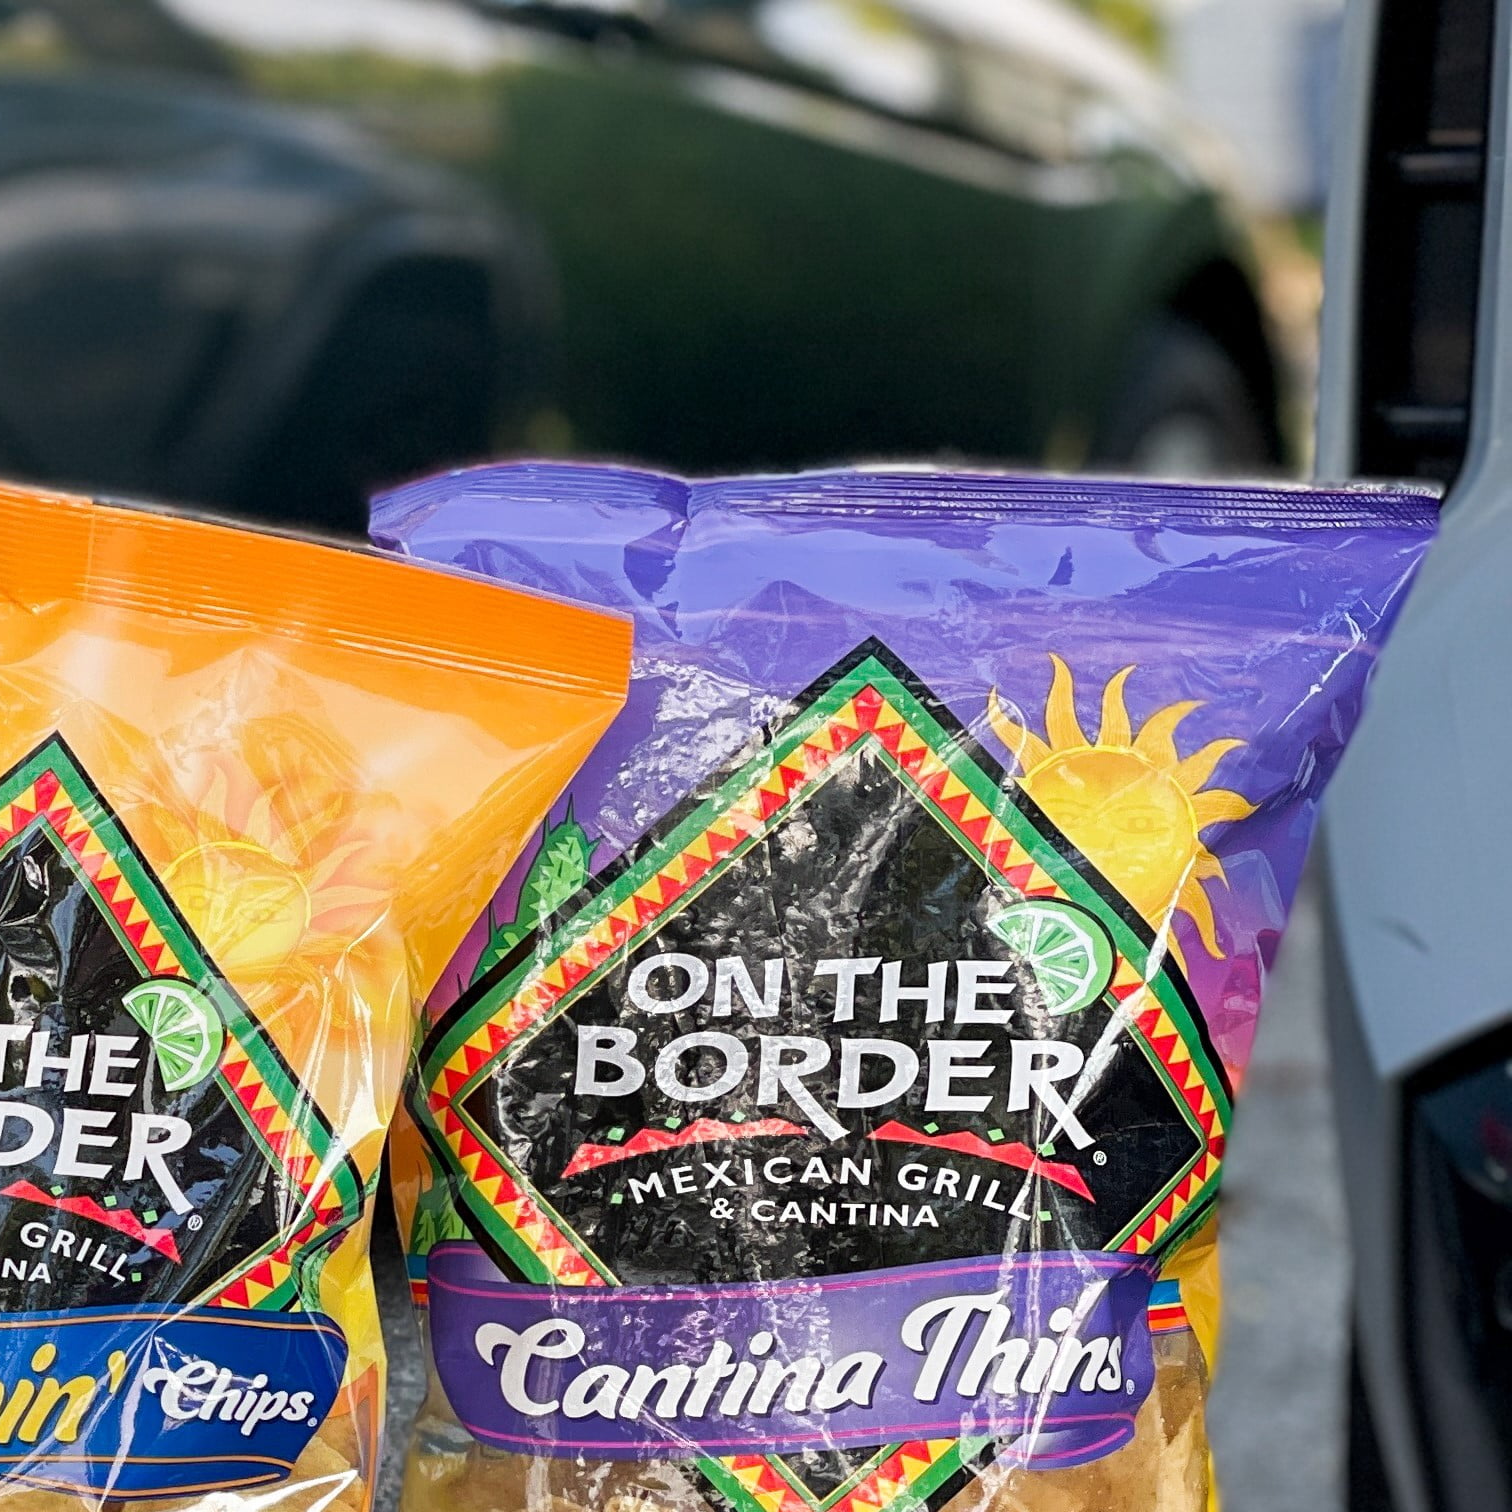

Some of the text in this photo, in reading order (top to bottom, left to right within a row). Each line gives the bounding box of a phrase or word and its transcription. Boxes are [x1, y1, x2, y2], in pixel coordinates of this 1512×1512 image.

[627, 952, 1017, 1026] ON THE
[573, 1024, 1097, 1150] BORDER
[628, 1157, 1035, 1221] MEXICAN GRILL
[709, 1198, 939, 1228] & CANTINA
[19, 1222, 130, 1286] GRILL
[475, 1293, 1124, 1419] Cantina Thins
[143, 1360, 314, 1436] Chips
